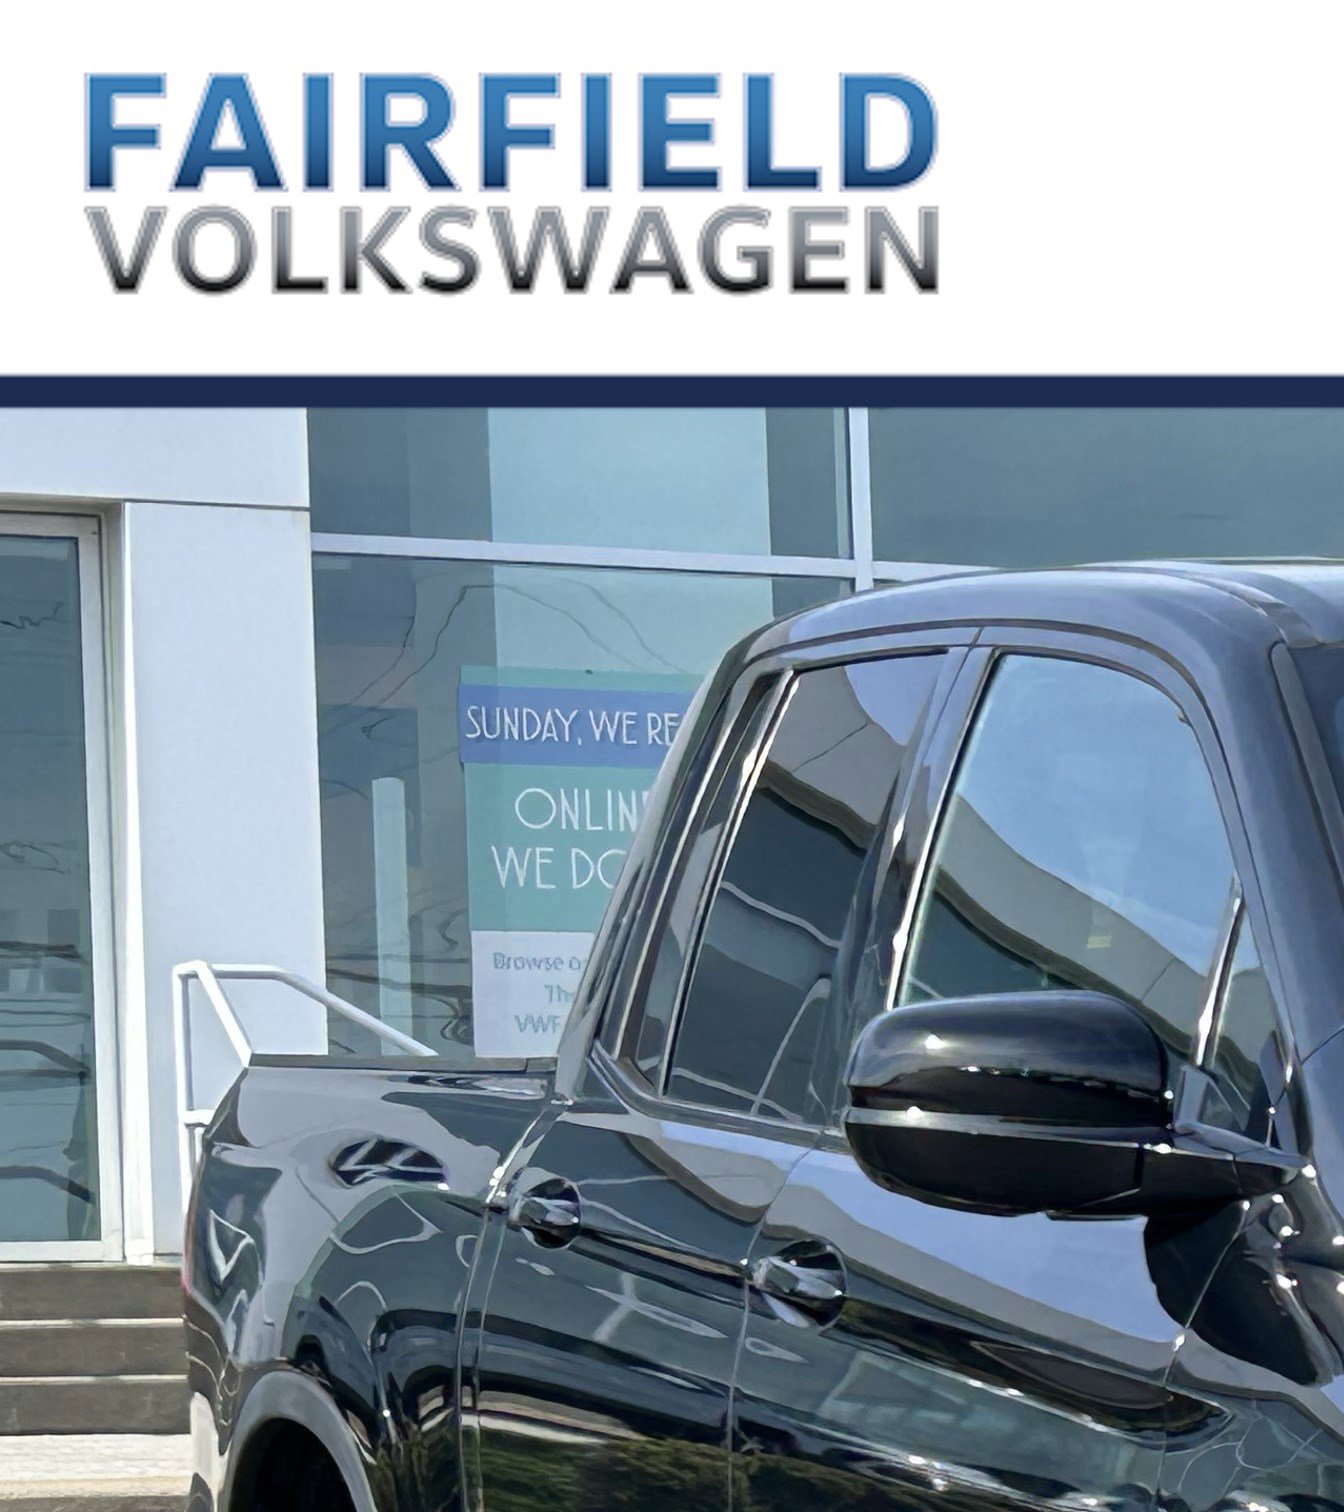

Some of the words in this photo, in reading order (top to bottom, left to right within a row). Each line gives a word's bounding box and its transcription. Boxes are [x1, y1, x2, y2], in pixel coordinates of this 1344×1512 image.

[465, 705, 582, 746] SUNDAY,
[588, 709, 638, 745] WE
[646, 712, 681, 746] RE
[514, 787, 650, 832] ONLIN
[491, 845, 556, 889] WE
[493, 952, 564, 971] Browse
